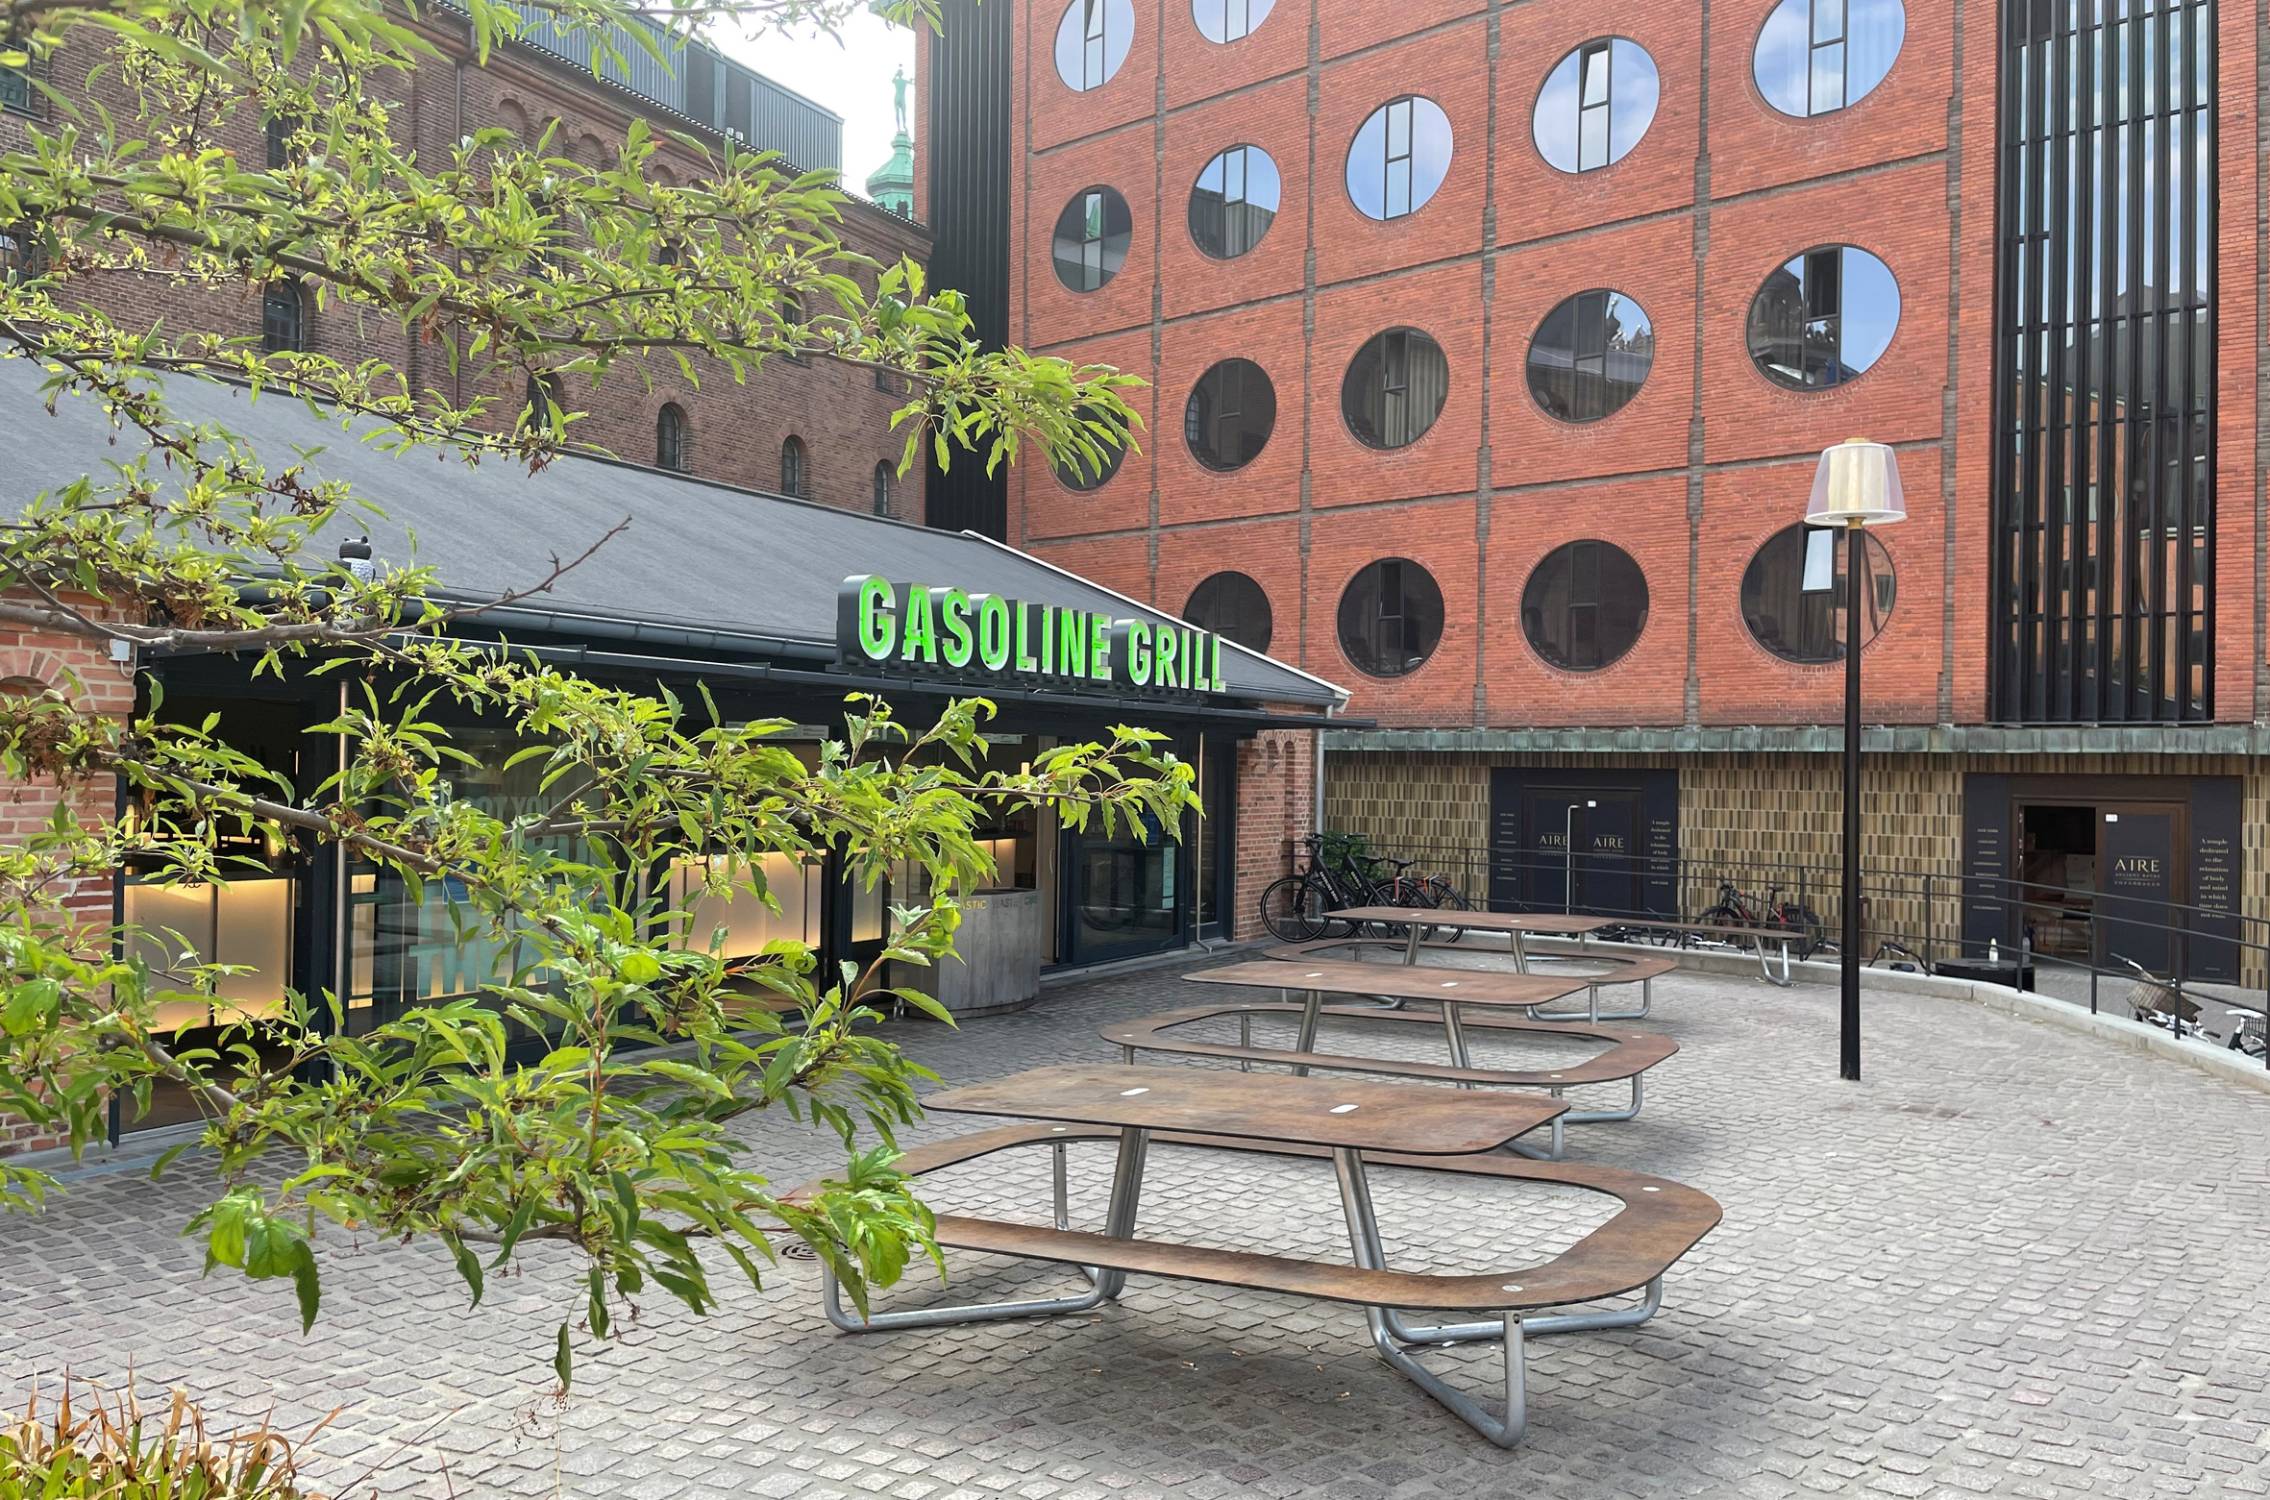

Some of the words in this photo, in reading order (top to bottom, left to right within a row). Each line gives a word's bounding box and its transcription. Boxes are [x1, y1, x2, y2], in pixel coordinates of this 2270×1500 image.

[856, 574, 1113, 681] GASOLINE
[1126, 618, 1226, 692] GRILL
[1538, 834, 1568, 846] AIRE
[1593, 837, 1624, 849] AIRE
[2114, 858, 2160, 873] AIRE
